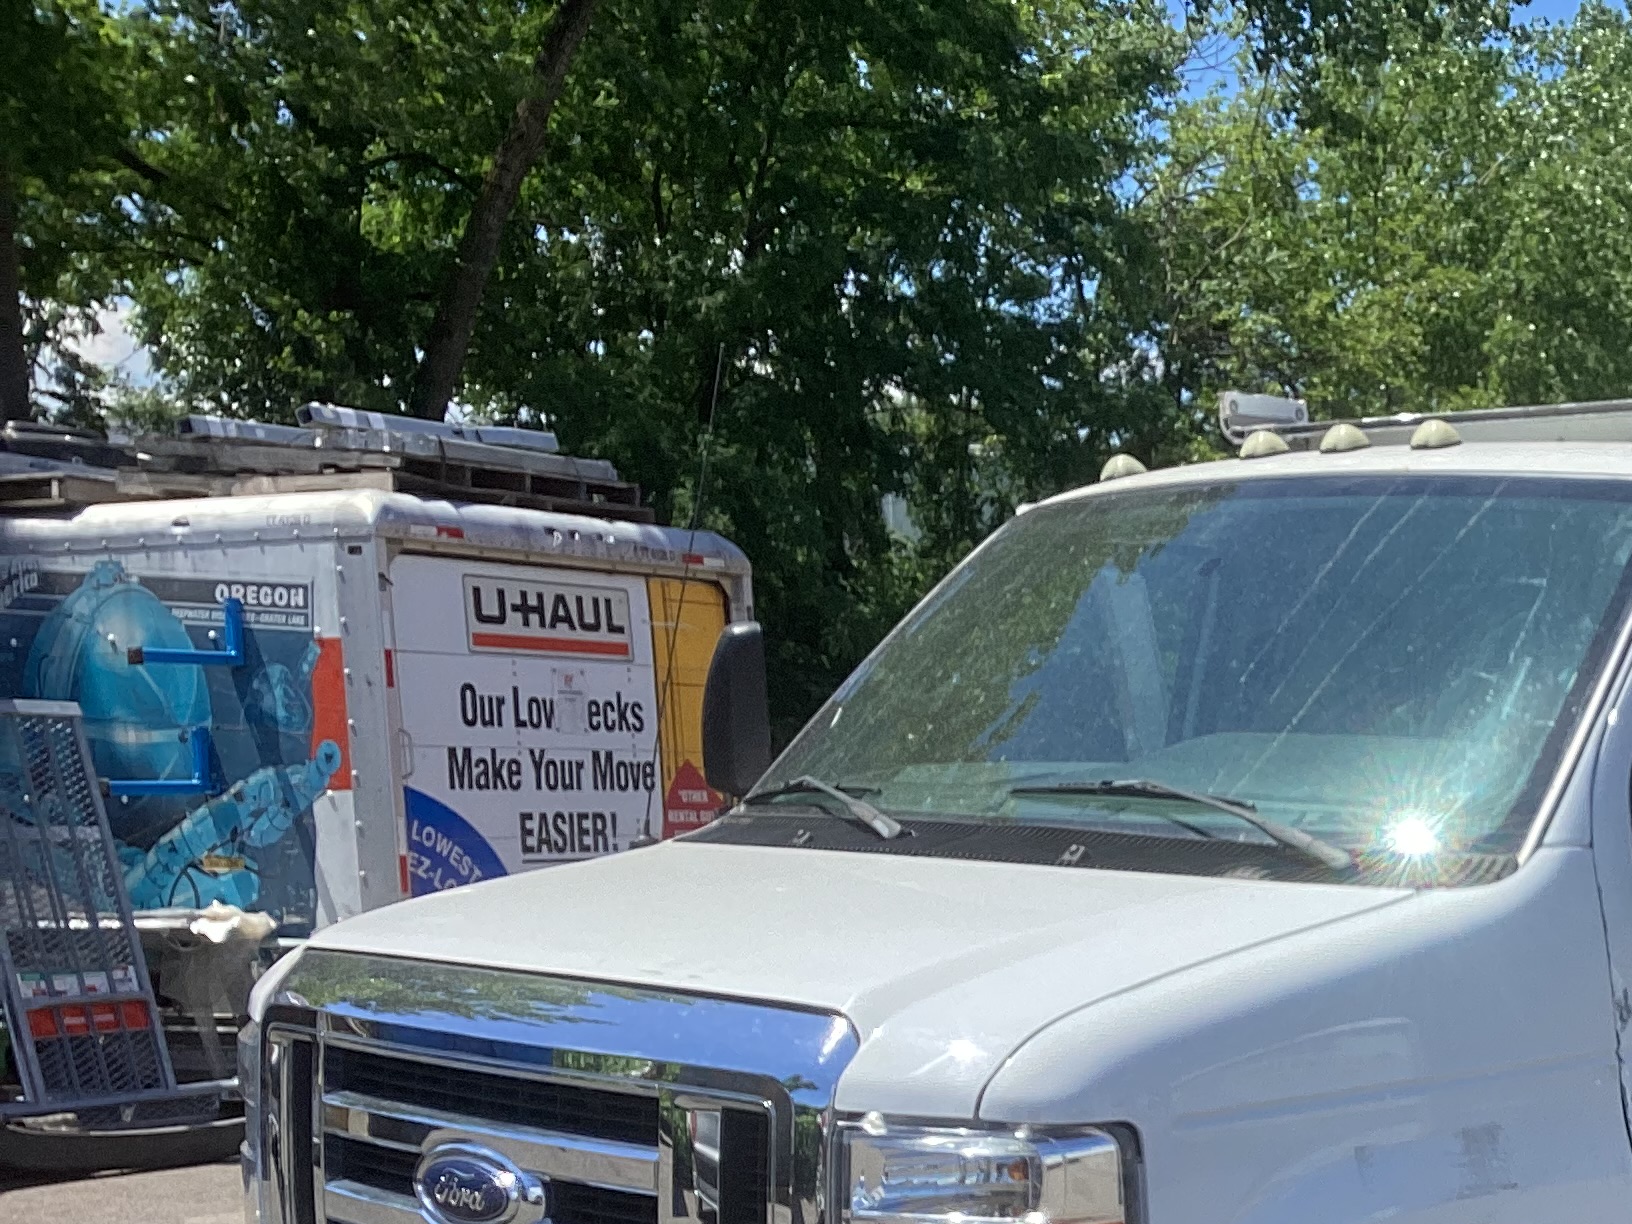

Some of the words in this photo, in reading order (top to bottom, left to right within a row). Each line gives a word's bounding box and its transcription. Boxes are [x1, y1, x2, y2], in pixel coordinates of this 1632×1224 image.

[215, 583, 304, 607] OREGON
[471, 585, 626, 635] U-HAUL
[460, 682, 505, 728] Our
[587, 691, 645, 733] ecks
[447, 746, 522, 792] Make
[529, 749, 585, 792] Your
[591, 750, 656, 793] Move
[411, 819, 483, 884] LOWEST
[519, 811, 619, 856] EASIER!
[434, 1166, 487, 1211] Ford
